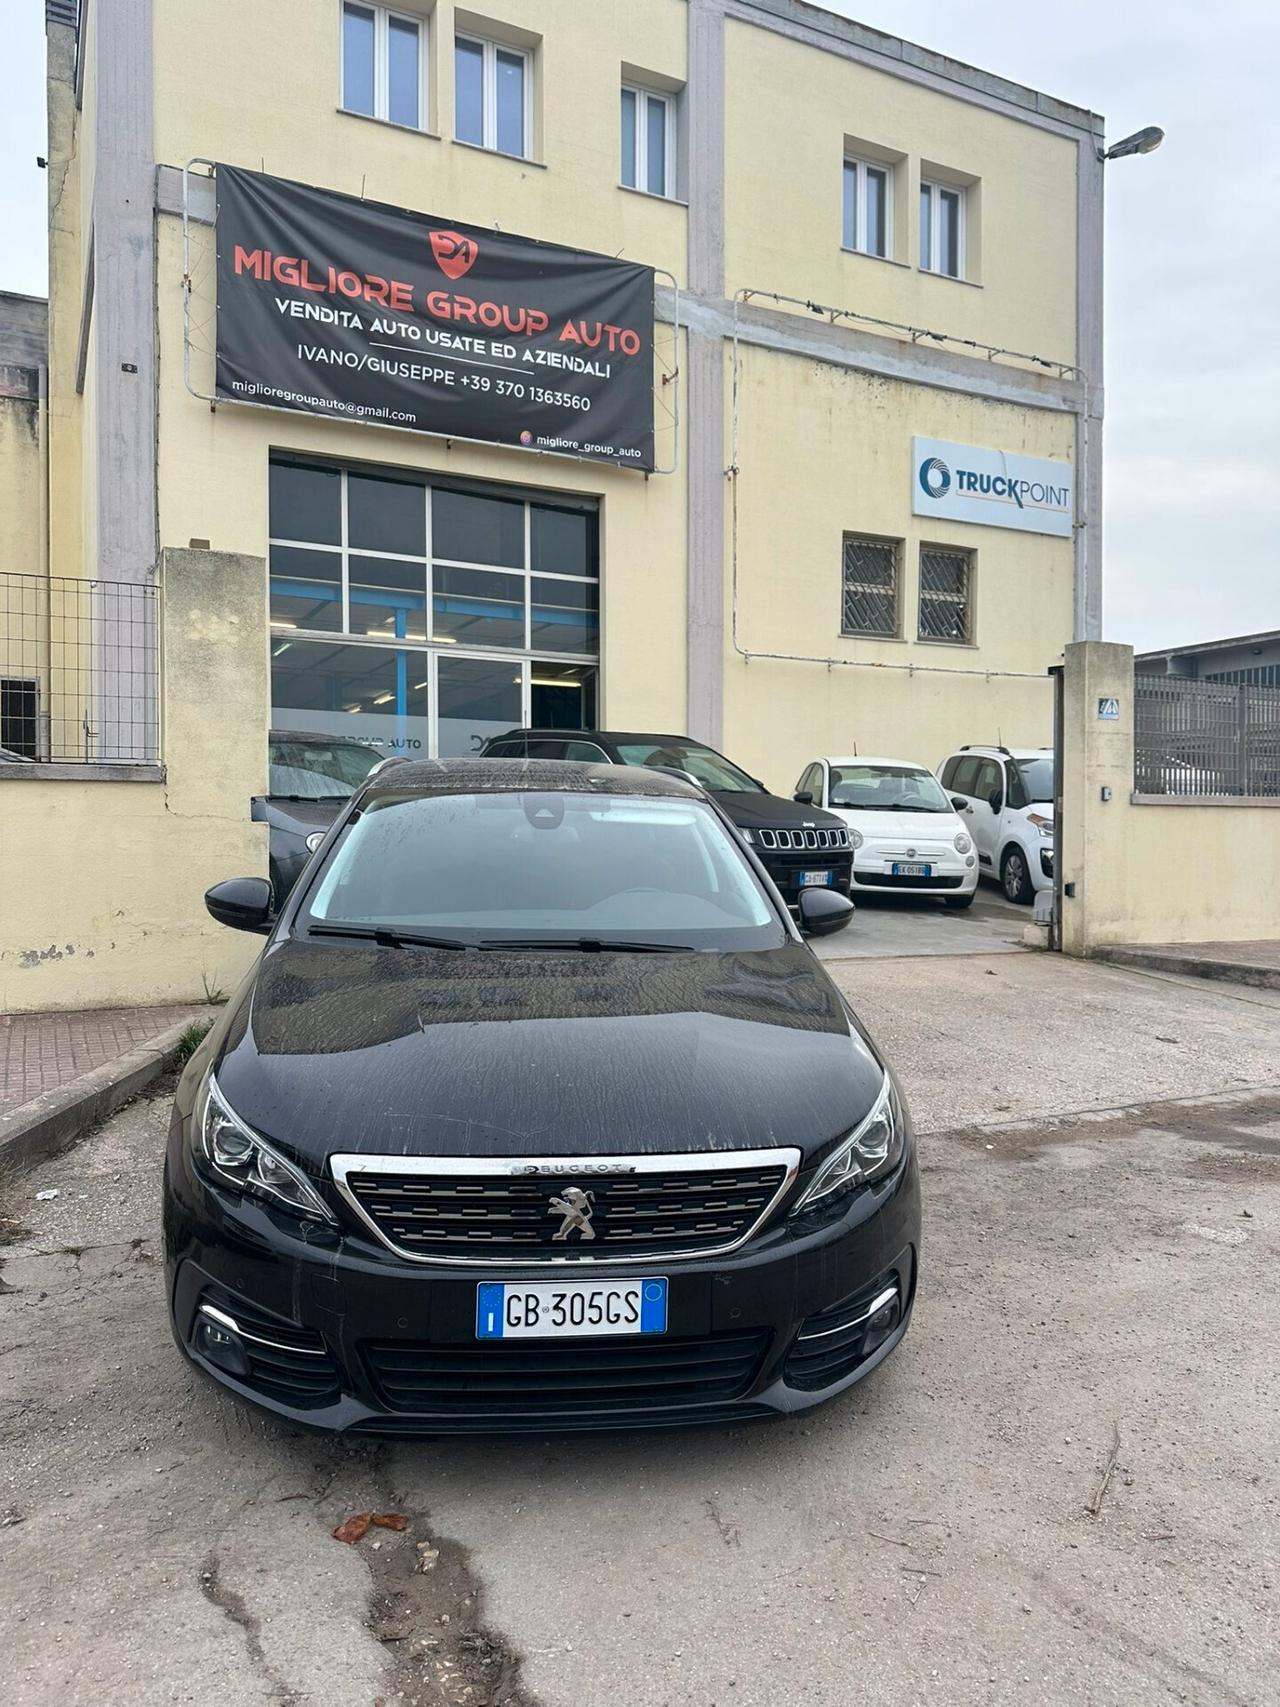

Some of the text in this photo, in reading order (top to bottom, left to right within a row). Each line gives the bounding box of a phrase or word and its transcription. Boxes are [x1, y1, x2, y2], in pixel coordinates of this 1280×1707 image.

[234, 244, 641, 356] MIGLIORE GROUP AUTO
[275, 297, 611, 379] VENDITA AUTO USATE ED AZIENDALI
[298, 344, 591, 411] IVANO/GIUSEPPE +39 370 1363560
[232, 379, 417, 423] miglioregroupauto@gmail.com
[537, 434, 642, 458] migliore_group_auto
[387, 737, 422, 749] AUTO
[524, 1164, 622, 1174] PEUGEOT
[506, 1293, 540, 1327] GB
[551, 1290, 639, 1326] 305GS
